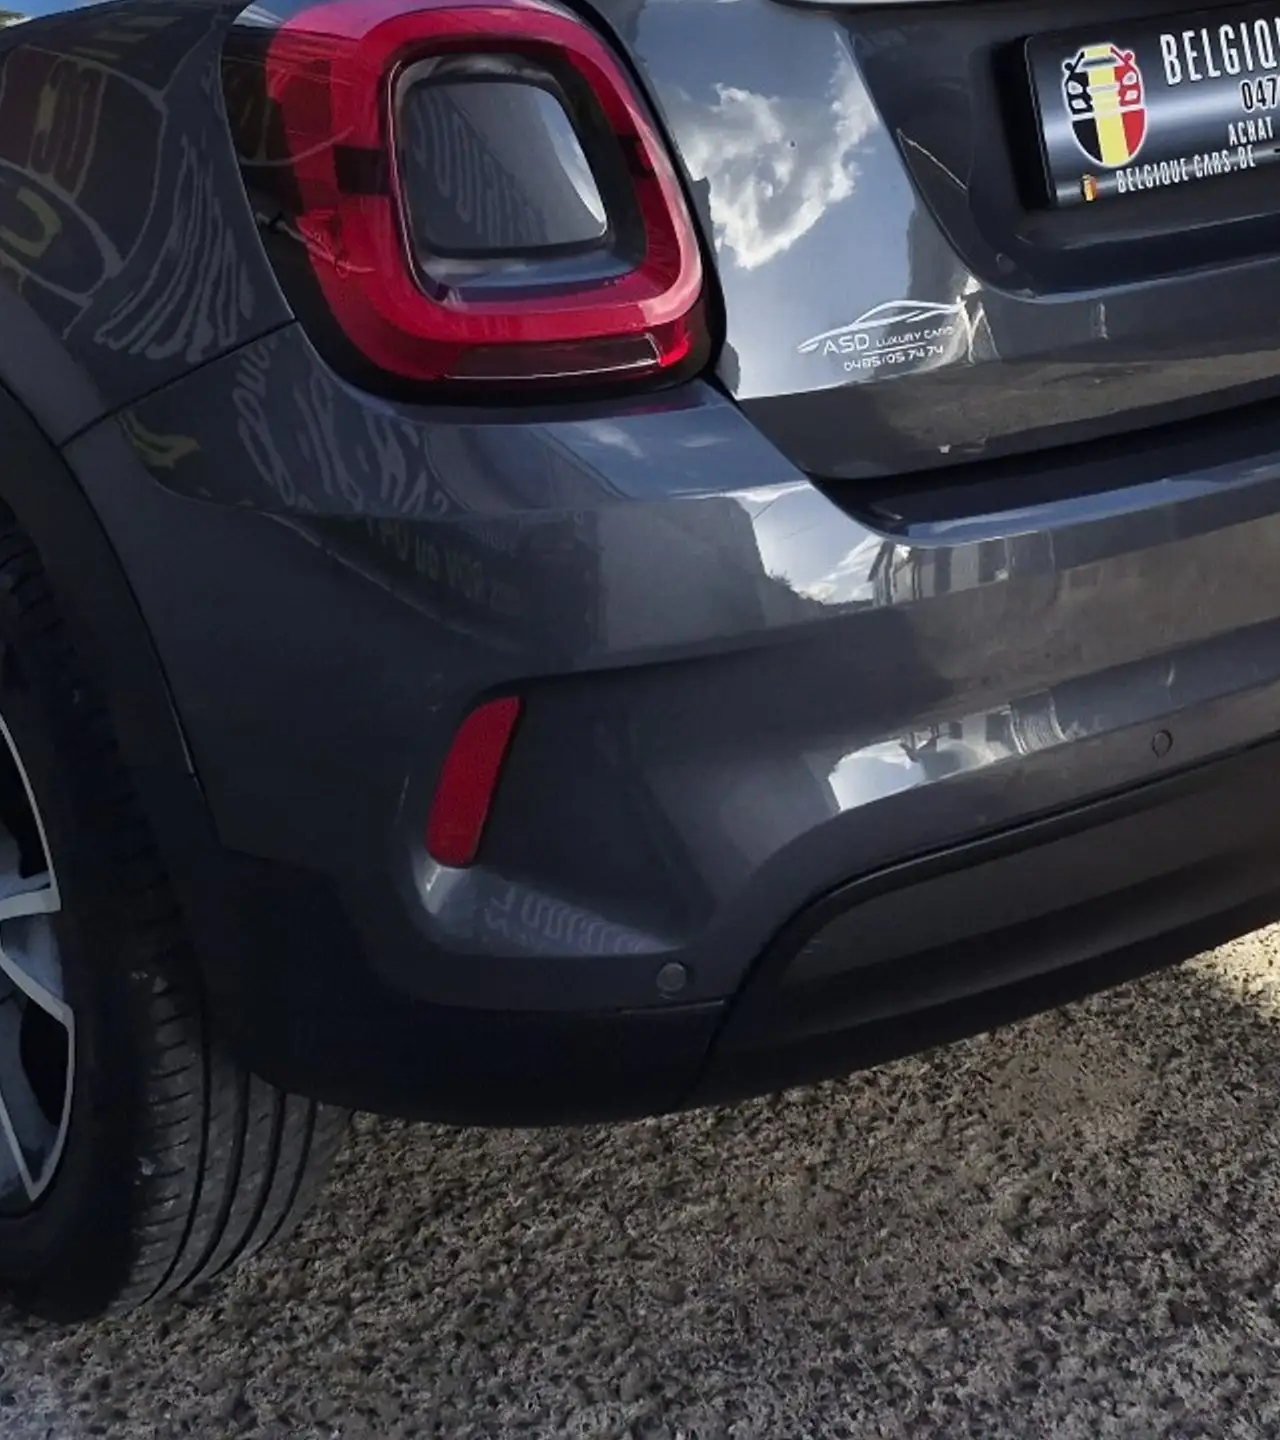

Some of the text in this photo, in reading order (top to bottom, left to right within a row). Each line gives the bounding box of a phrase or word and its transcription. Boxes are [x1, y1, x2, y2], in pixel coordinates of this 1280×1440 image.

[1228, 116, 1273, 146] ACHAT
[1116, 156, 1190, 194] BELGIQUE
[822, 333, 870, 356] ASD
[876, 331, 922, 348] LUXURY
